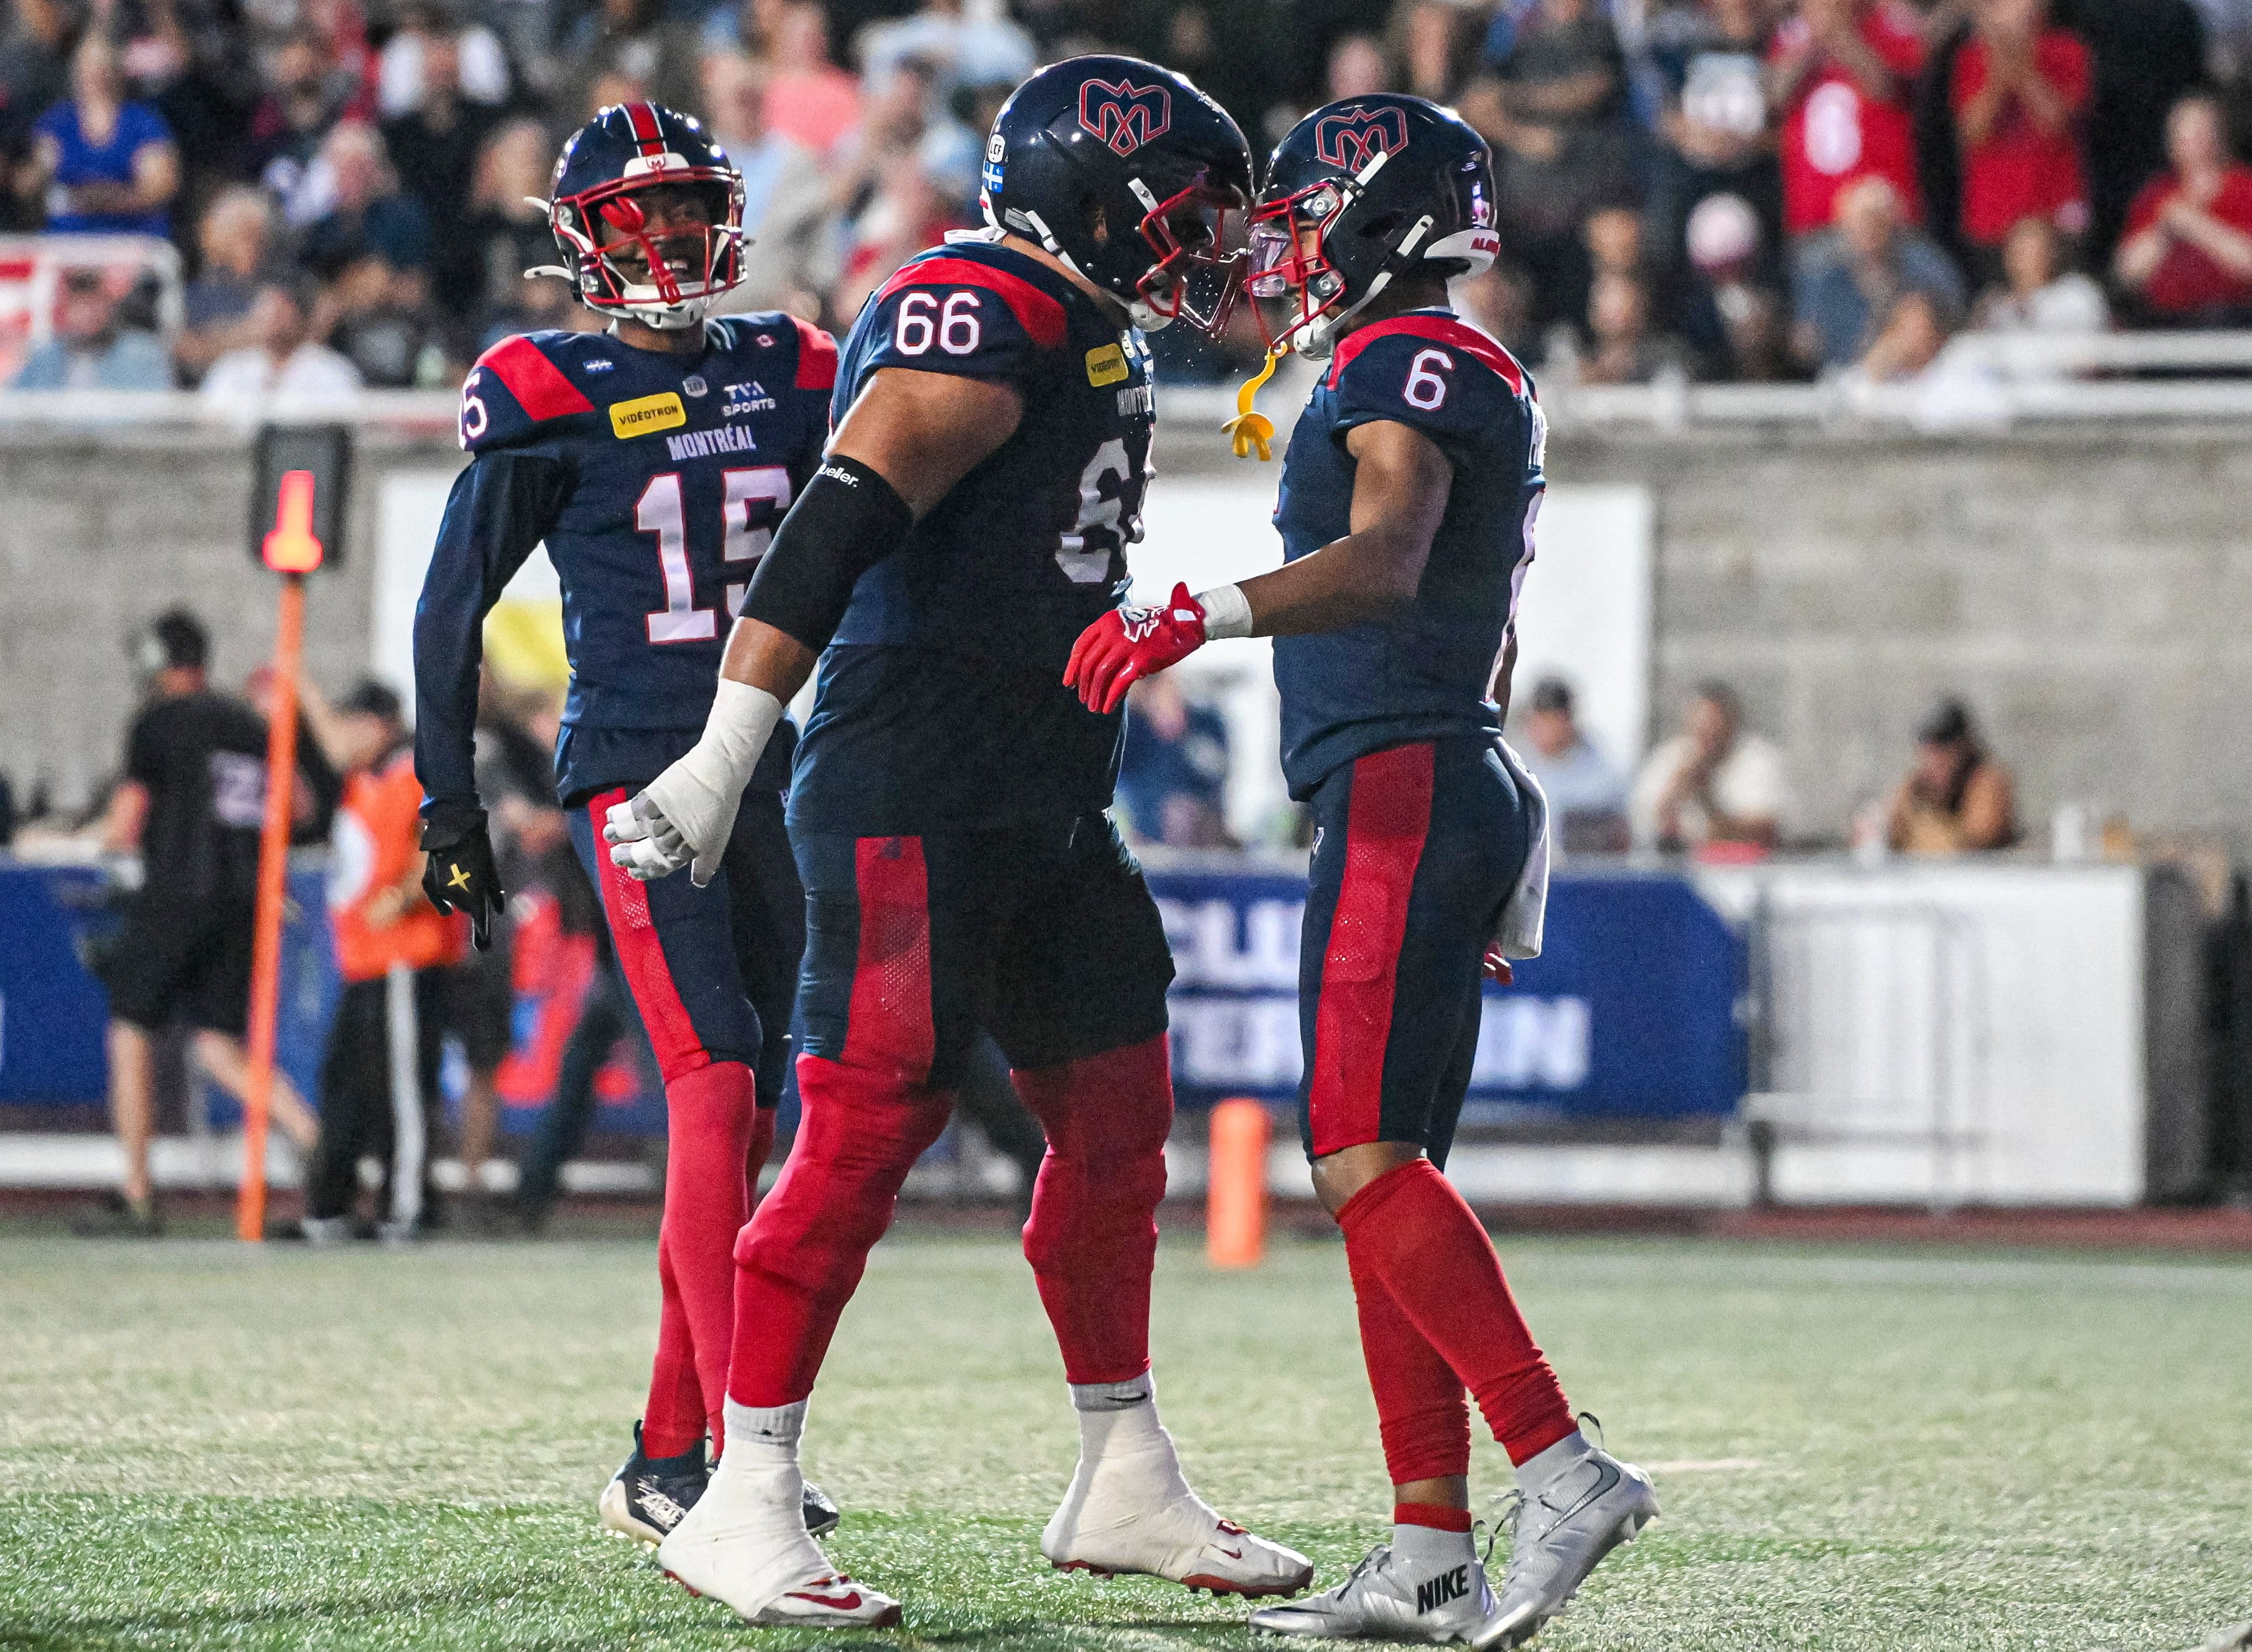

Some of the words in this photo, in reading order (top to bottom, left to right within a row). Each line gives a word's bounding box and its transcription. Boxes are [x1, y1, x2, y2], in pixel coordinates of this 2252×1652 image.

[895, 290, 982, 357] 66
[1402, 347, 1456, 411] 6
[618, 405, 679, 425] VIDÉOTRON
[722, 397, 776, 417] SPORTS
[666, 422, 757, 461] MONTRÉAL
[633, 464, 792, 645] 15
[1417, 1563, 1469, 1615] NIKE
